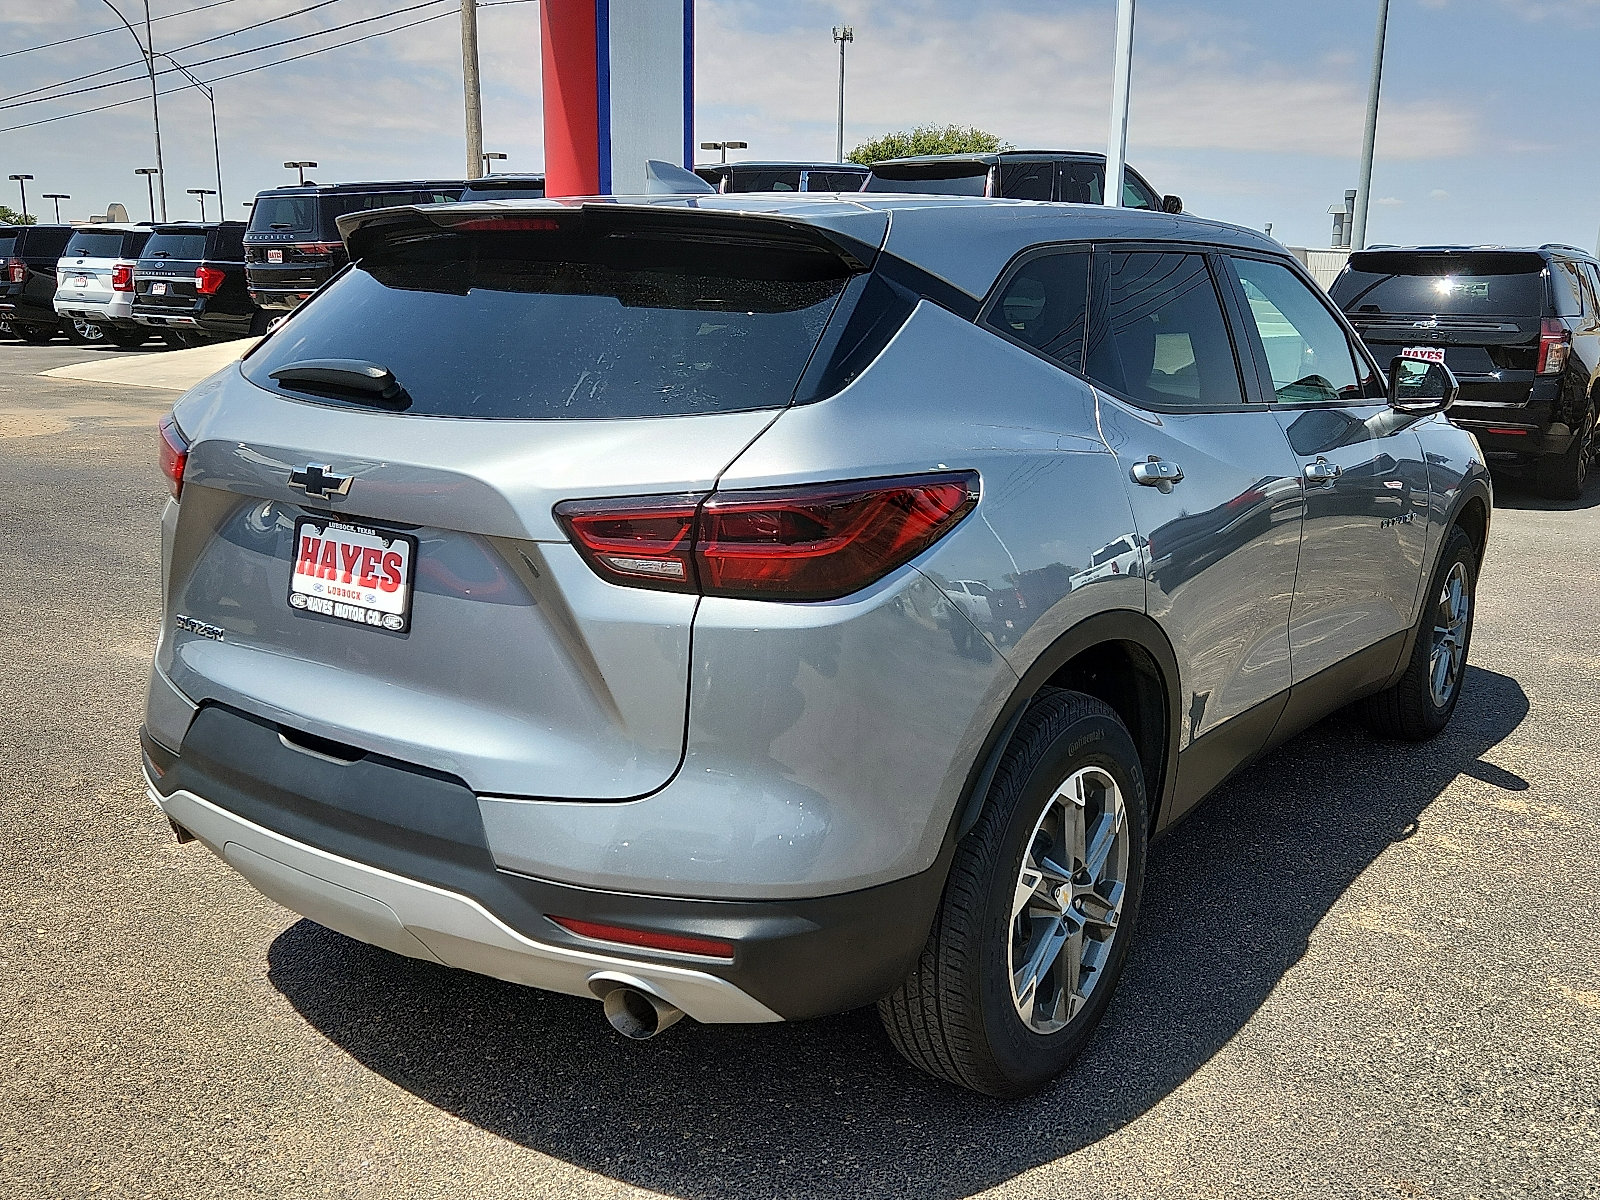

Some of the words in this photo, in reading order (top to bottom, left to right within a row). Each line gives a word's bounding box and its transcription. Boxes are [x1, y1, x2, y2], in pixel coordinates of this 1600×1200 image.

[356, 526, 376, 536] TEXAS
[296, 536, 403, 593] HAYES
[327, 586, 362, 600] LUBBOCK
[307, 596, 333, 616] HAYES
[334, 602, 365, 623] MOTOR
[366, 610, 382, 627] CO.
[1067, 728, 1101, 757] Continental
